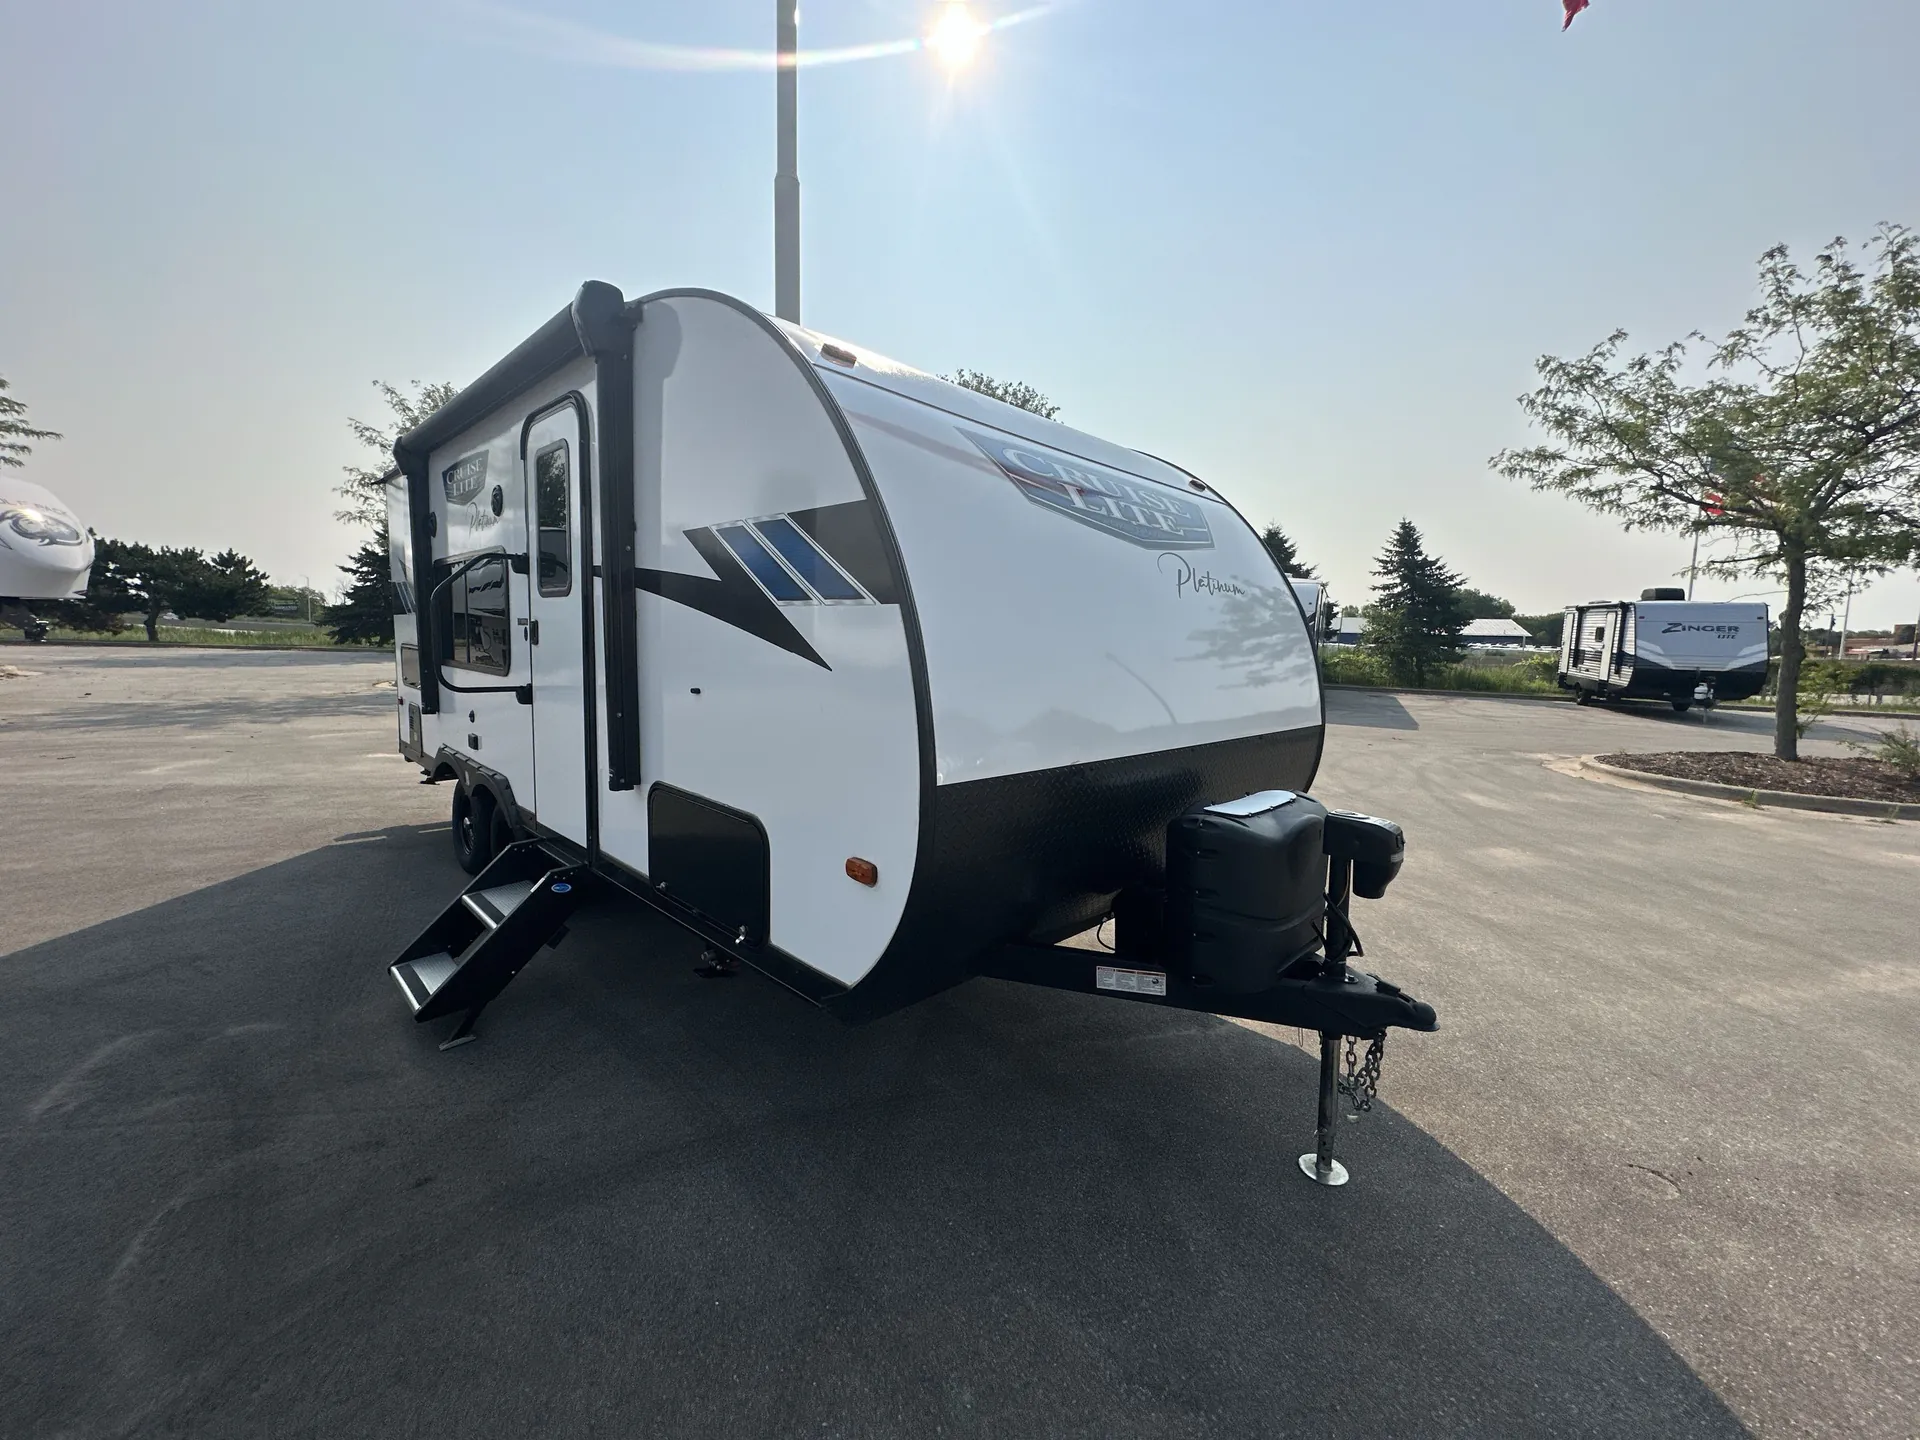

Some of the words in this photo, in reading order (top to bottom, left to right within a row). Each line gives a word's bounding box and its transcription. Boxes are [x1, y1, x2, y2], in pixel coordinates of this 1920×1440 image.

[447, 458, 483, 485] CRUISE
[453, 476, 477, 495] LITE
[1002, 447, 1191, 519] CRUISE
[1057, 482, 1185, 536] LITE
[1157, 552, 1246, 599] Platinum
